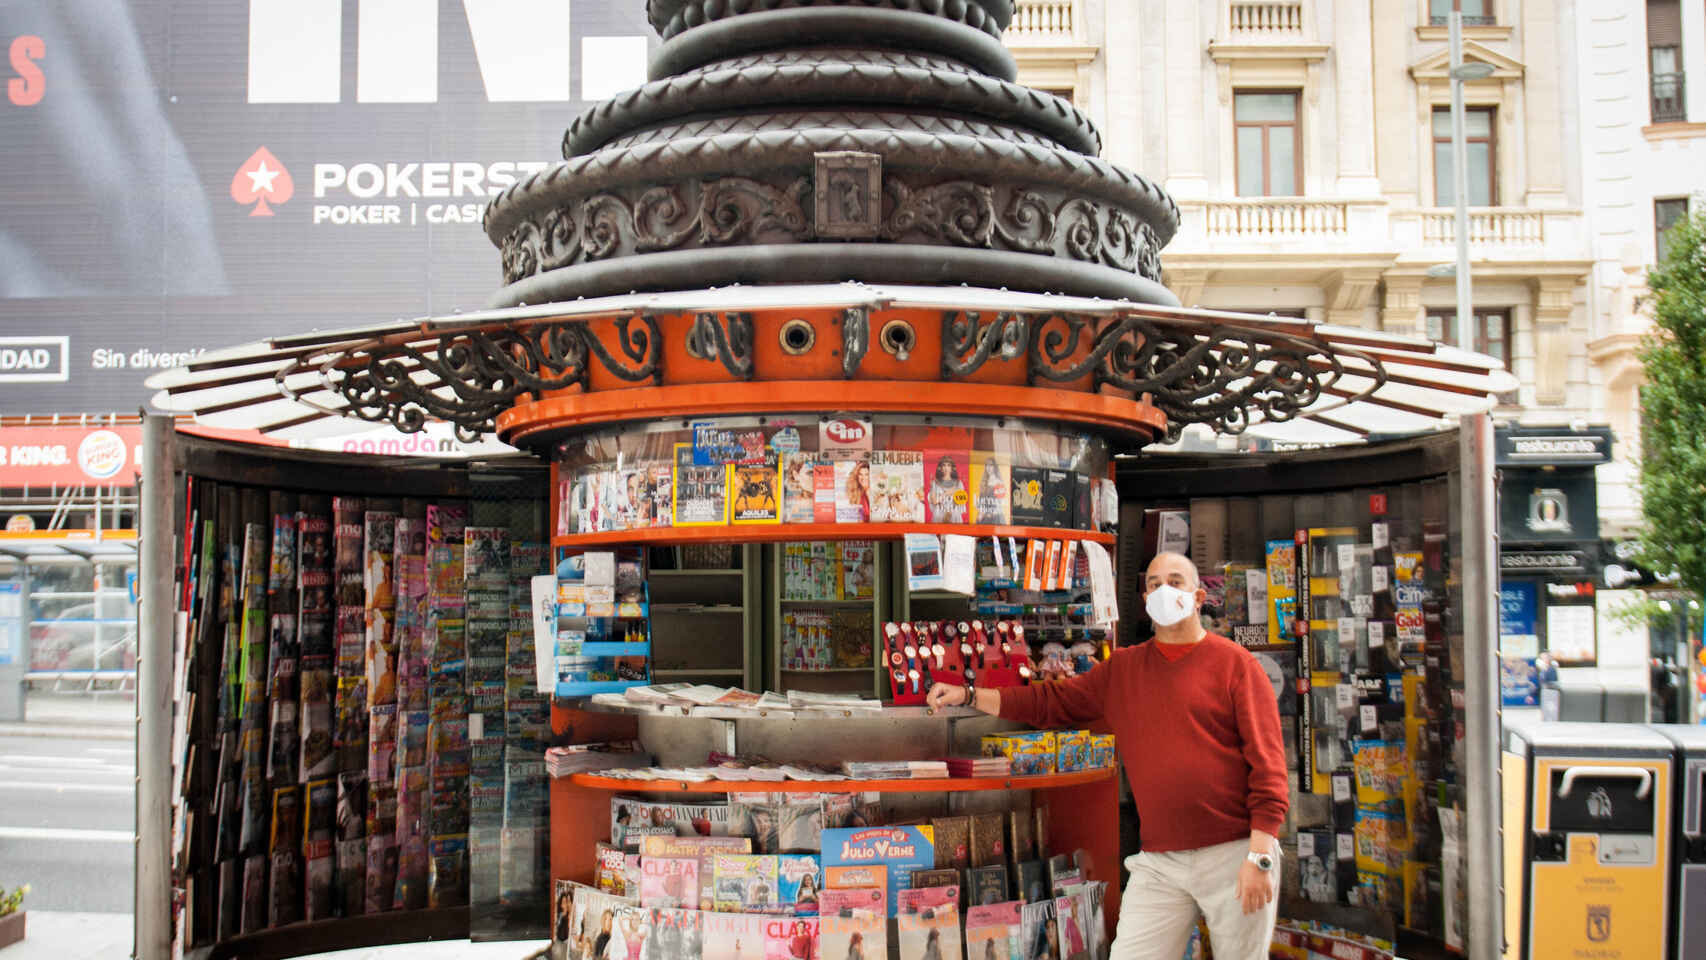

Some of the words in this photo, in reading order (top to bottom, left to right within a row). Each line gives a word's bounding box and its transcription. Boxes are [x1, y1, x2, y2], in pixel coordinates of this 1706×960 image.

[313, 205, 400, 224] POKER
[92, 348, 126, 368] Sin
[130, 348, 206, 368] diversi
